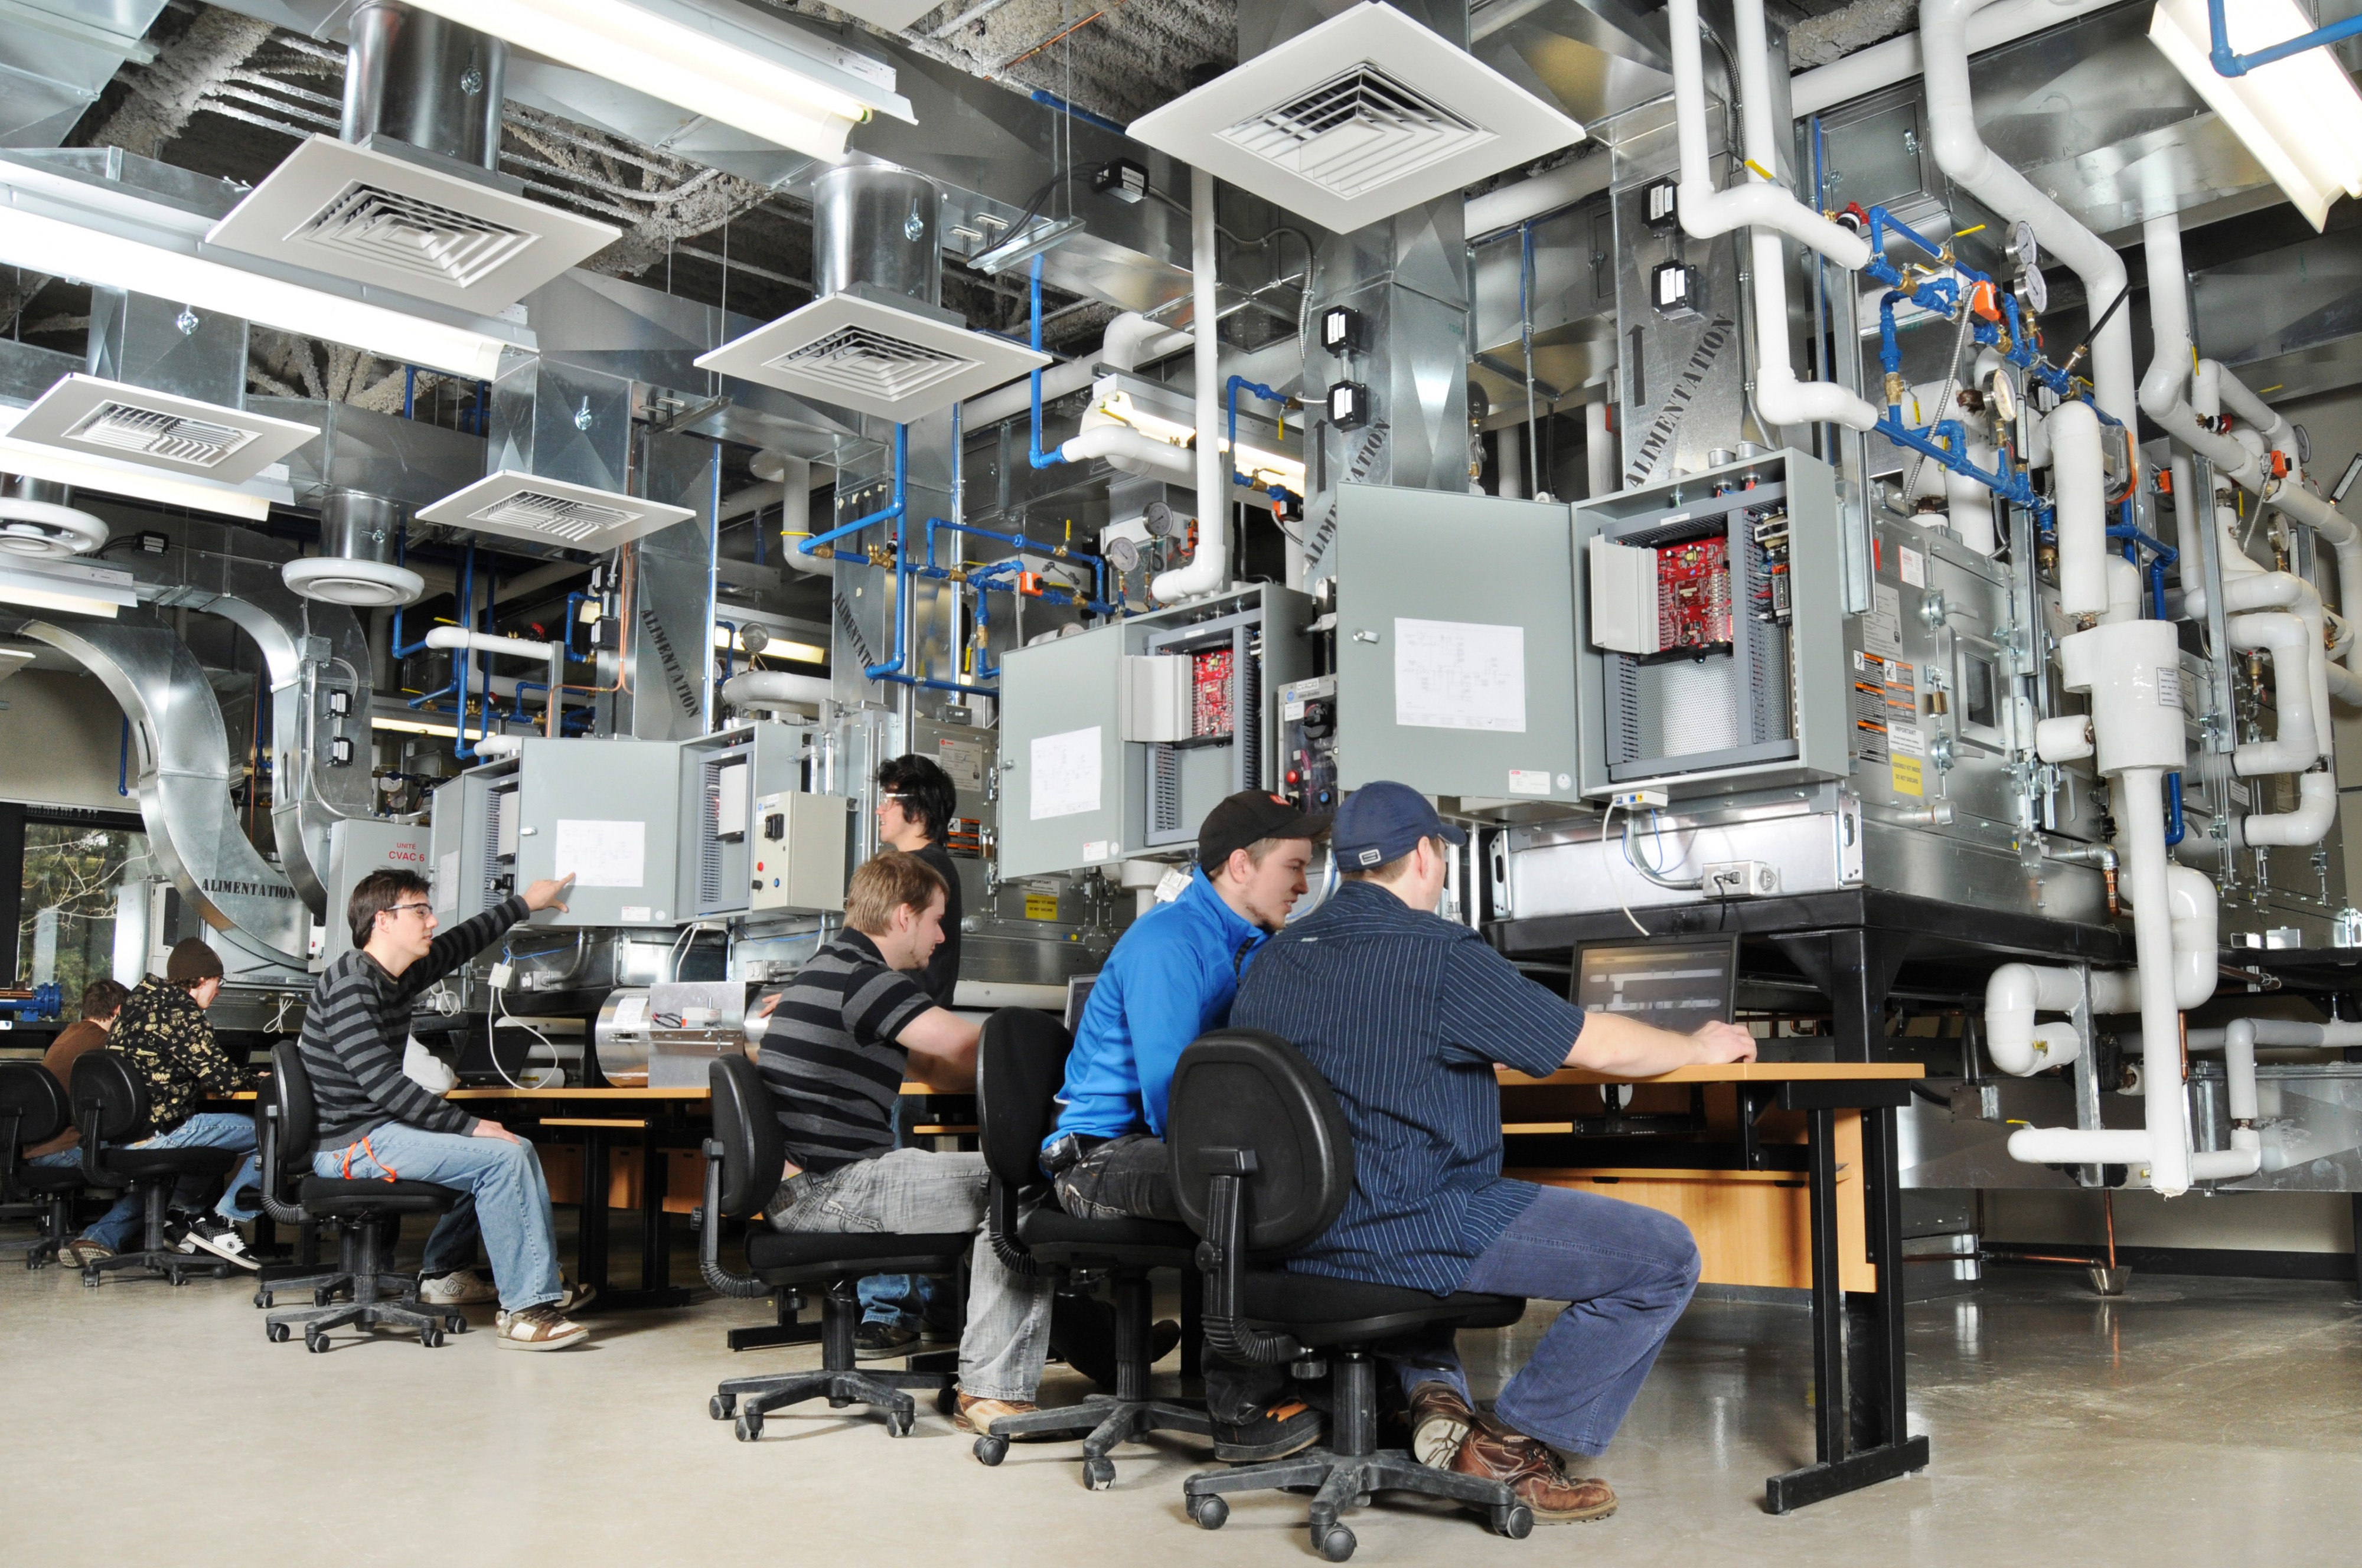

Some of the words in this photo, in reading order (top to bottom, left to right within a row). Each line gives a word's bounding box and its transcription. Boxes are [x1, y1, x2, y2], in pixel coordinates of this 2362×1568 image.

[1625, 313, 1735, 488] ALIMENTATION
[1304, 417, 1391, 570] ALIMATION
[641, 609, 701, 718] ALIMENTATION
[833, 592, 876, 686] ALIMENTATI
[1894, 725, 1916, 736] IMPORTANT
[201, 878, 296, 900] ALIMENTATION
[389, 851, 416, 861] CVAC
[419, 854, 425, 862] 6
